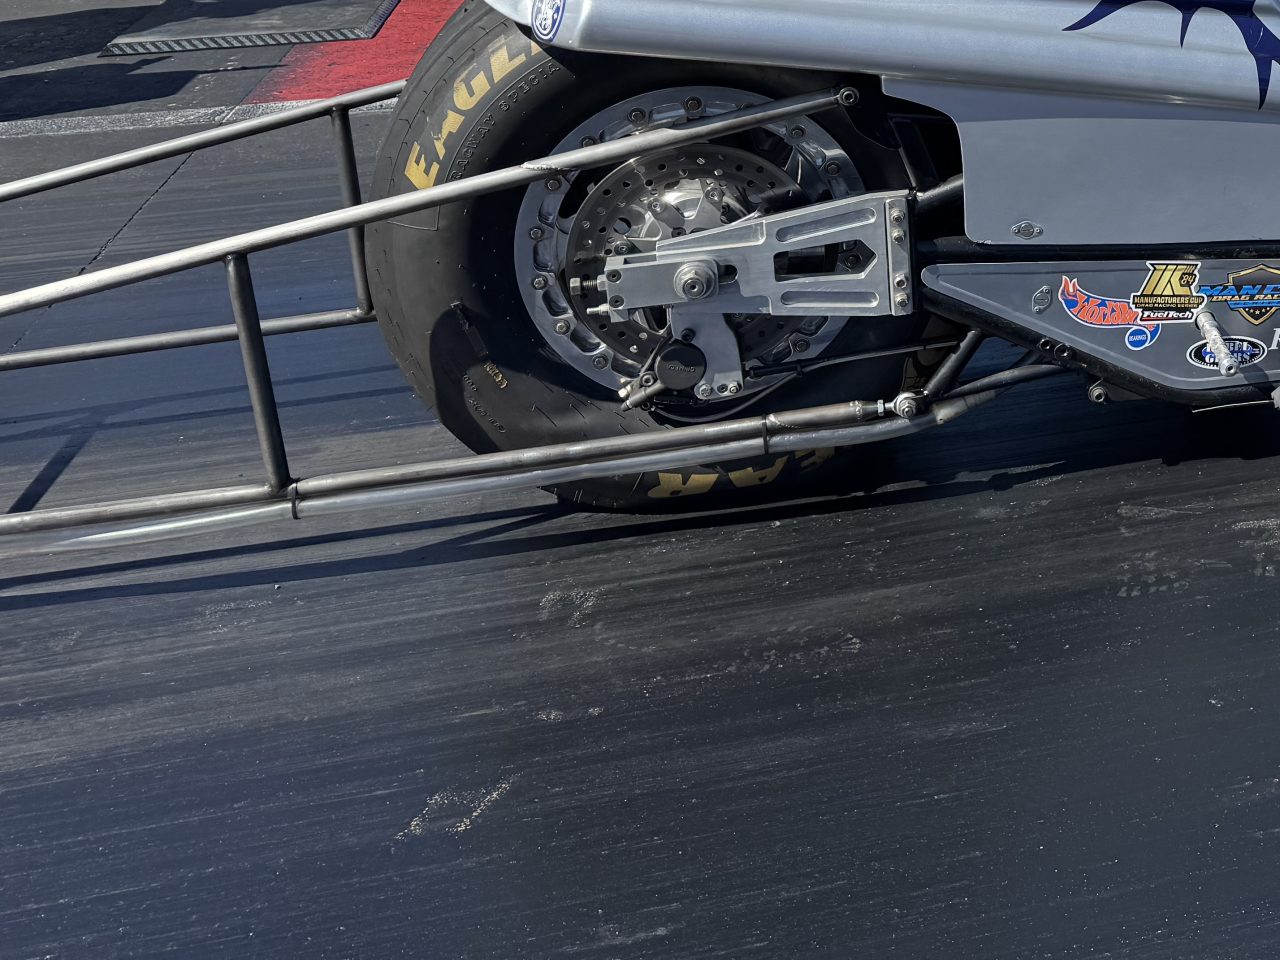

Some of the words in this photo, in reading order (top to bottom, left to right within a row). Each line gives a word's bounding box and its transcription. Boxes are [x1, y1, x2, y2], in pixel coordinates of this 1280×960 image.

[1201, 284, 1260, 295] MAN
[1210, 294, 1250, 302] DRAG
[1142, 310, 1193, 319] FuelTech
[1128, 334, 1147, 342] BEARINGS
